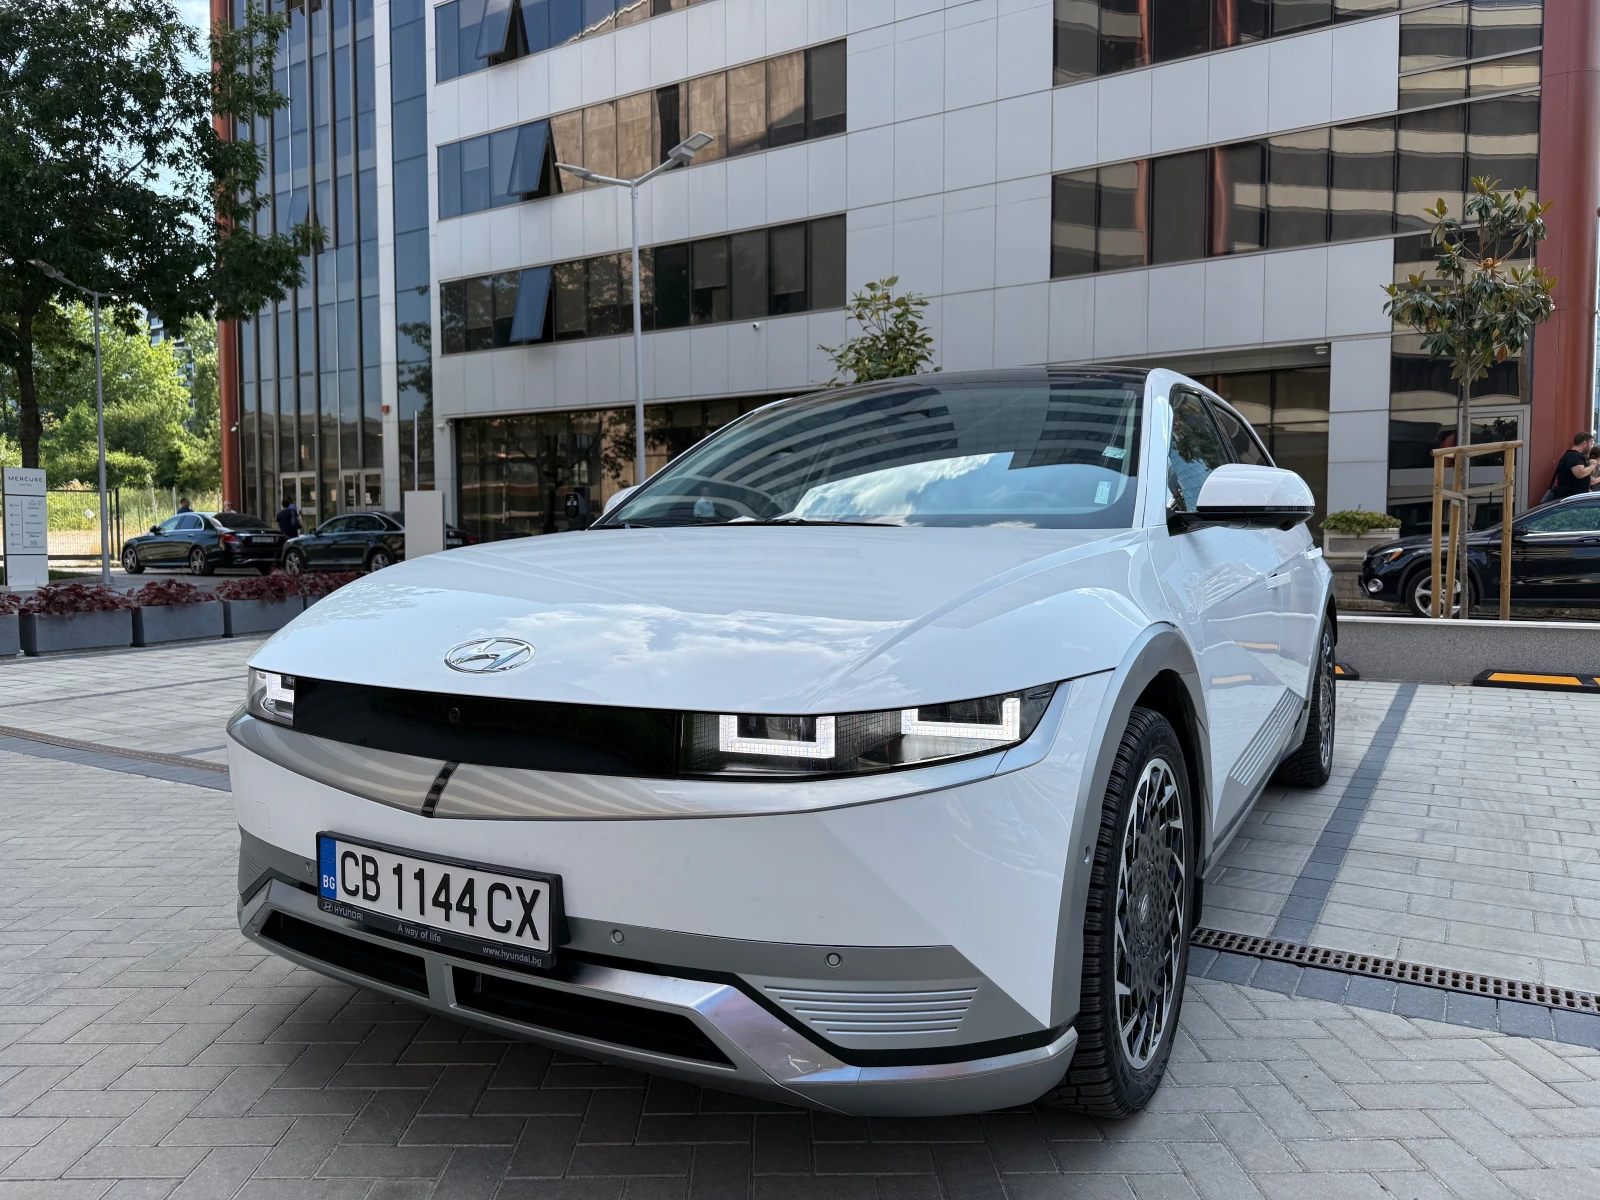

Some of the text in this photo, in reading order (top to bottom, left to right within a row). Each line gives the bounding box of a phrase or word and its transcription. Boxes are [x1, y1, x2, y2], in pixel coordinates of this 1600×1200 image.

[8, 475, 43, 483] MERCURE
[323, 874, 336, 890] BG
[340, 850, 541, 942] CB 1144 CX
[333, 905, 364, 922] HYUNDAI
[397, 923, 442, 943] A way of life
[482, 945, 542, 967] www.hyundai.bg
